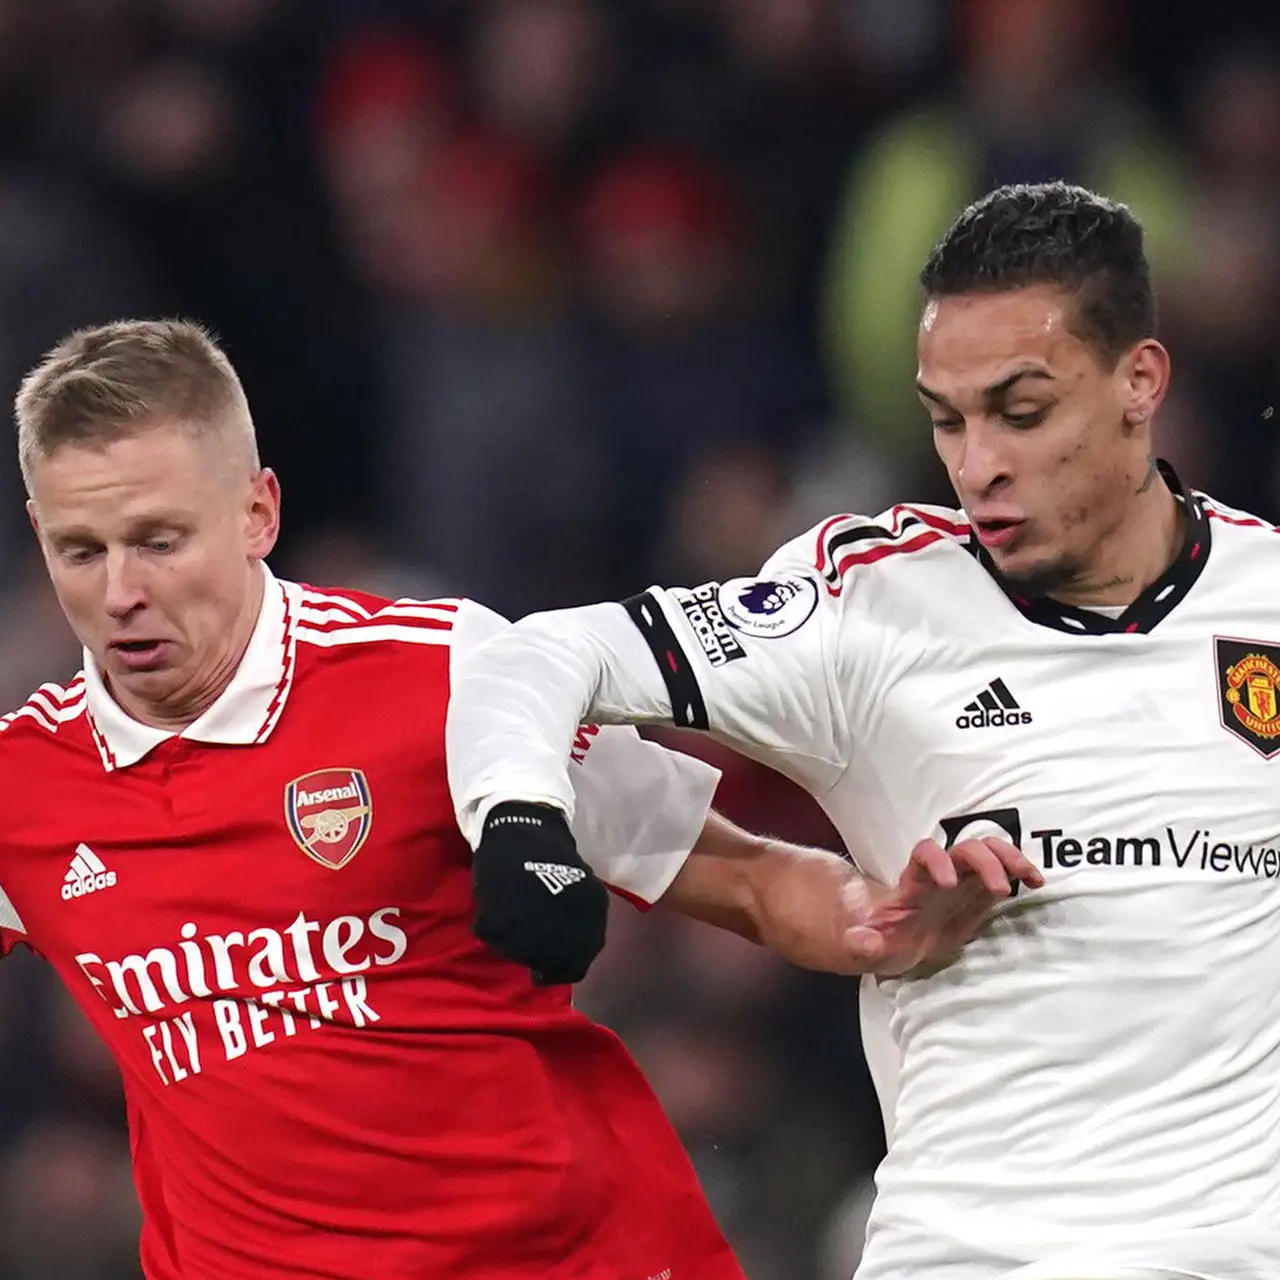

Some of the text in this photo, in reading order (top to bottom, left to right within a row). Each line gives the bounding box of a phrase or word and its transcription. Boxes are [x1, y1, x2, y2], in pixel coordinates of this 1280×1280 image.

[684, 603, 727, 667] racism
[955, 710, 1033, 729] adidas
[296, 780, 359, 807] Arsenal
[61, 870, 116, 900] adidas
[75, 906, 408, 1018] Emirates
[142, 975, 380, 1087] FLY BETTER
